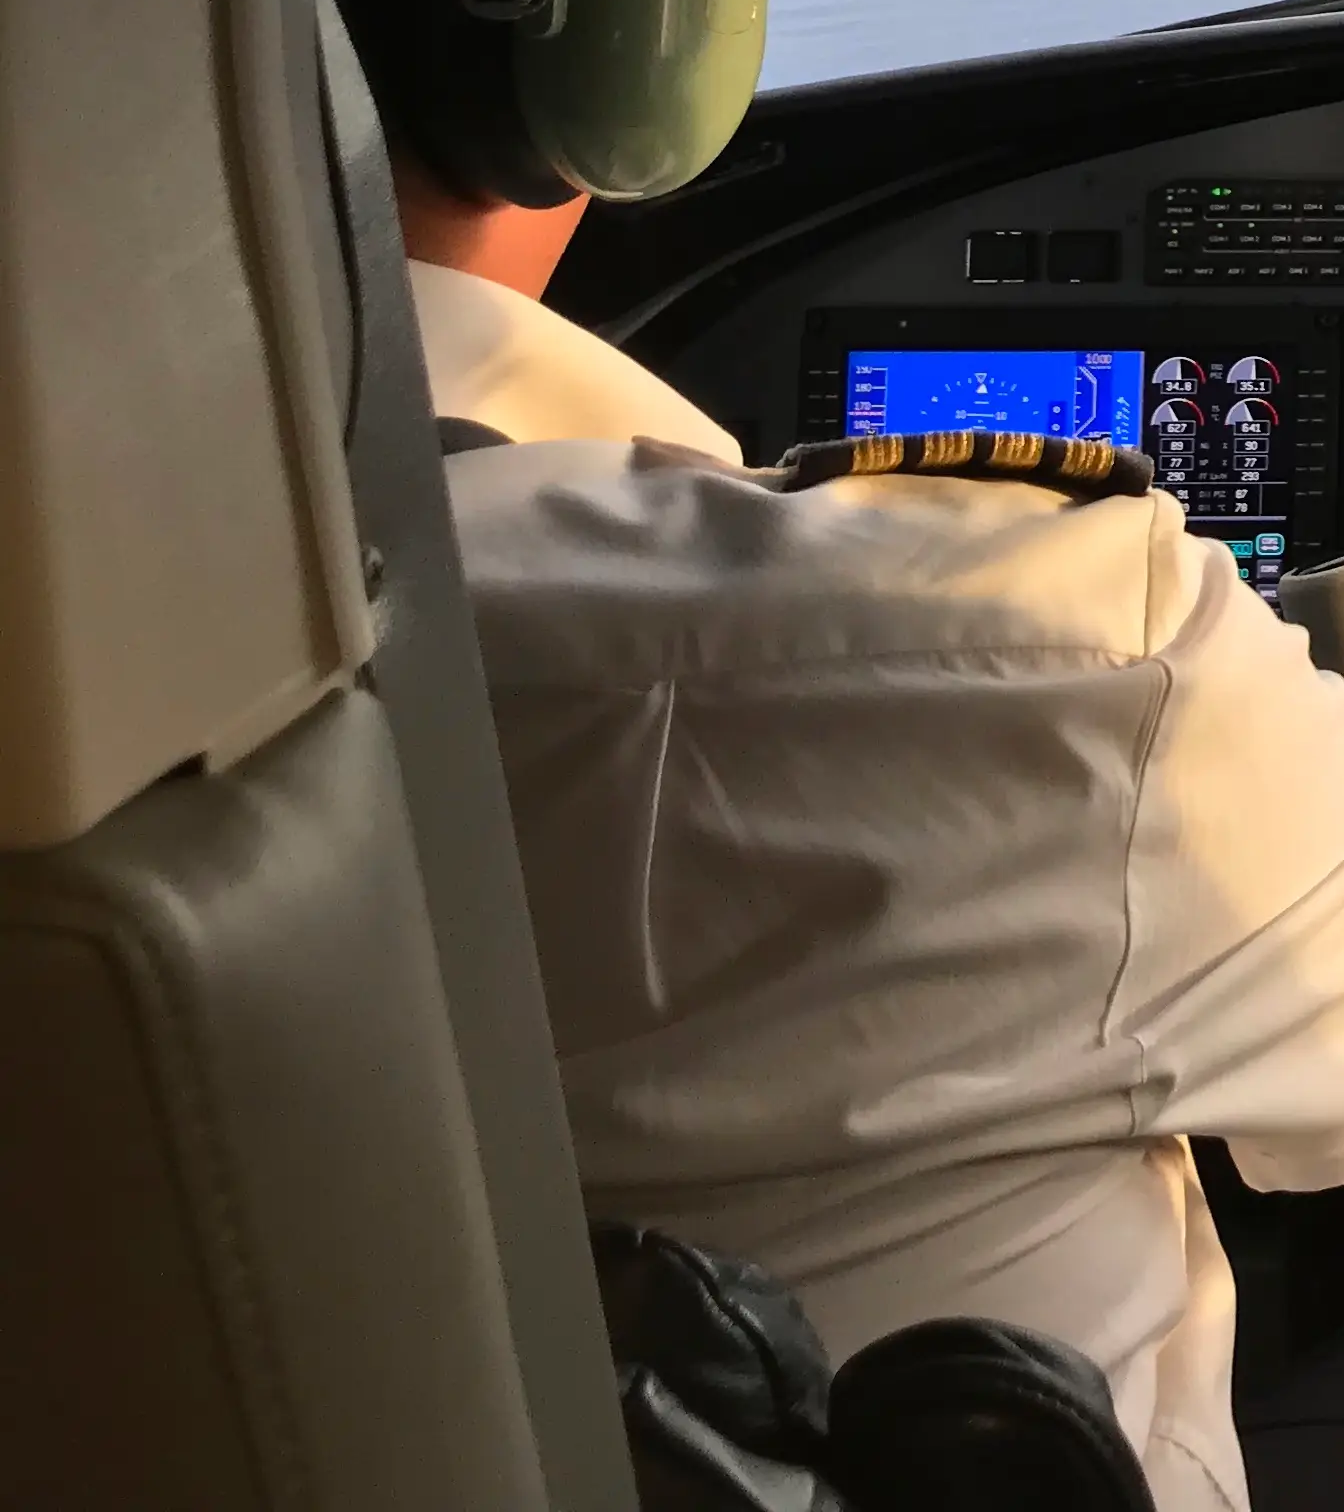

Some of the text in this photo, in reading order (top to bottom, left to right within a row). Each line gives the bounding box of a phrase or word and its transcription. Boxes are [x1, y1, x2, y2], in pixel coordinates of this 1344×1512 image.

[1165, 381, 1265, 391] 34.8 35.1
[1166, 423, 1187, 433] 627
[1169, 458, 1257, 468] 77 77
